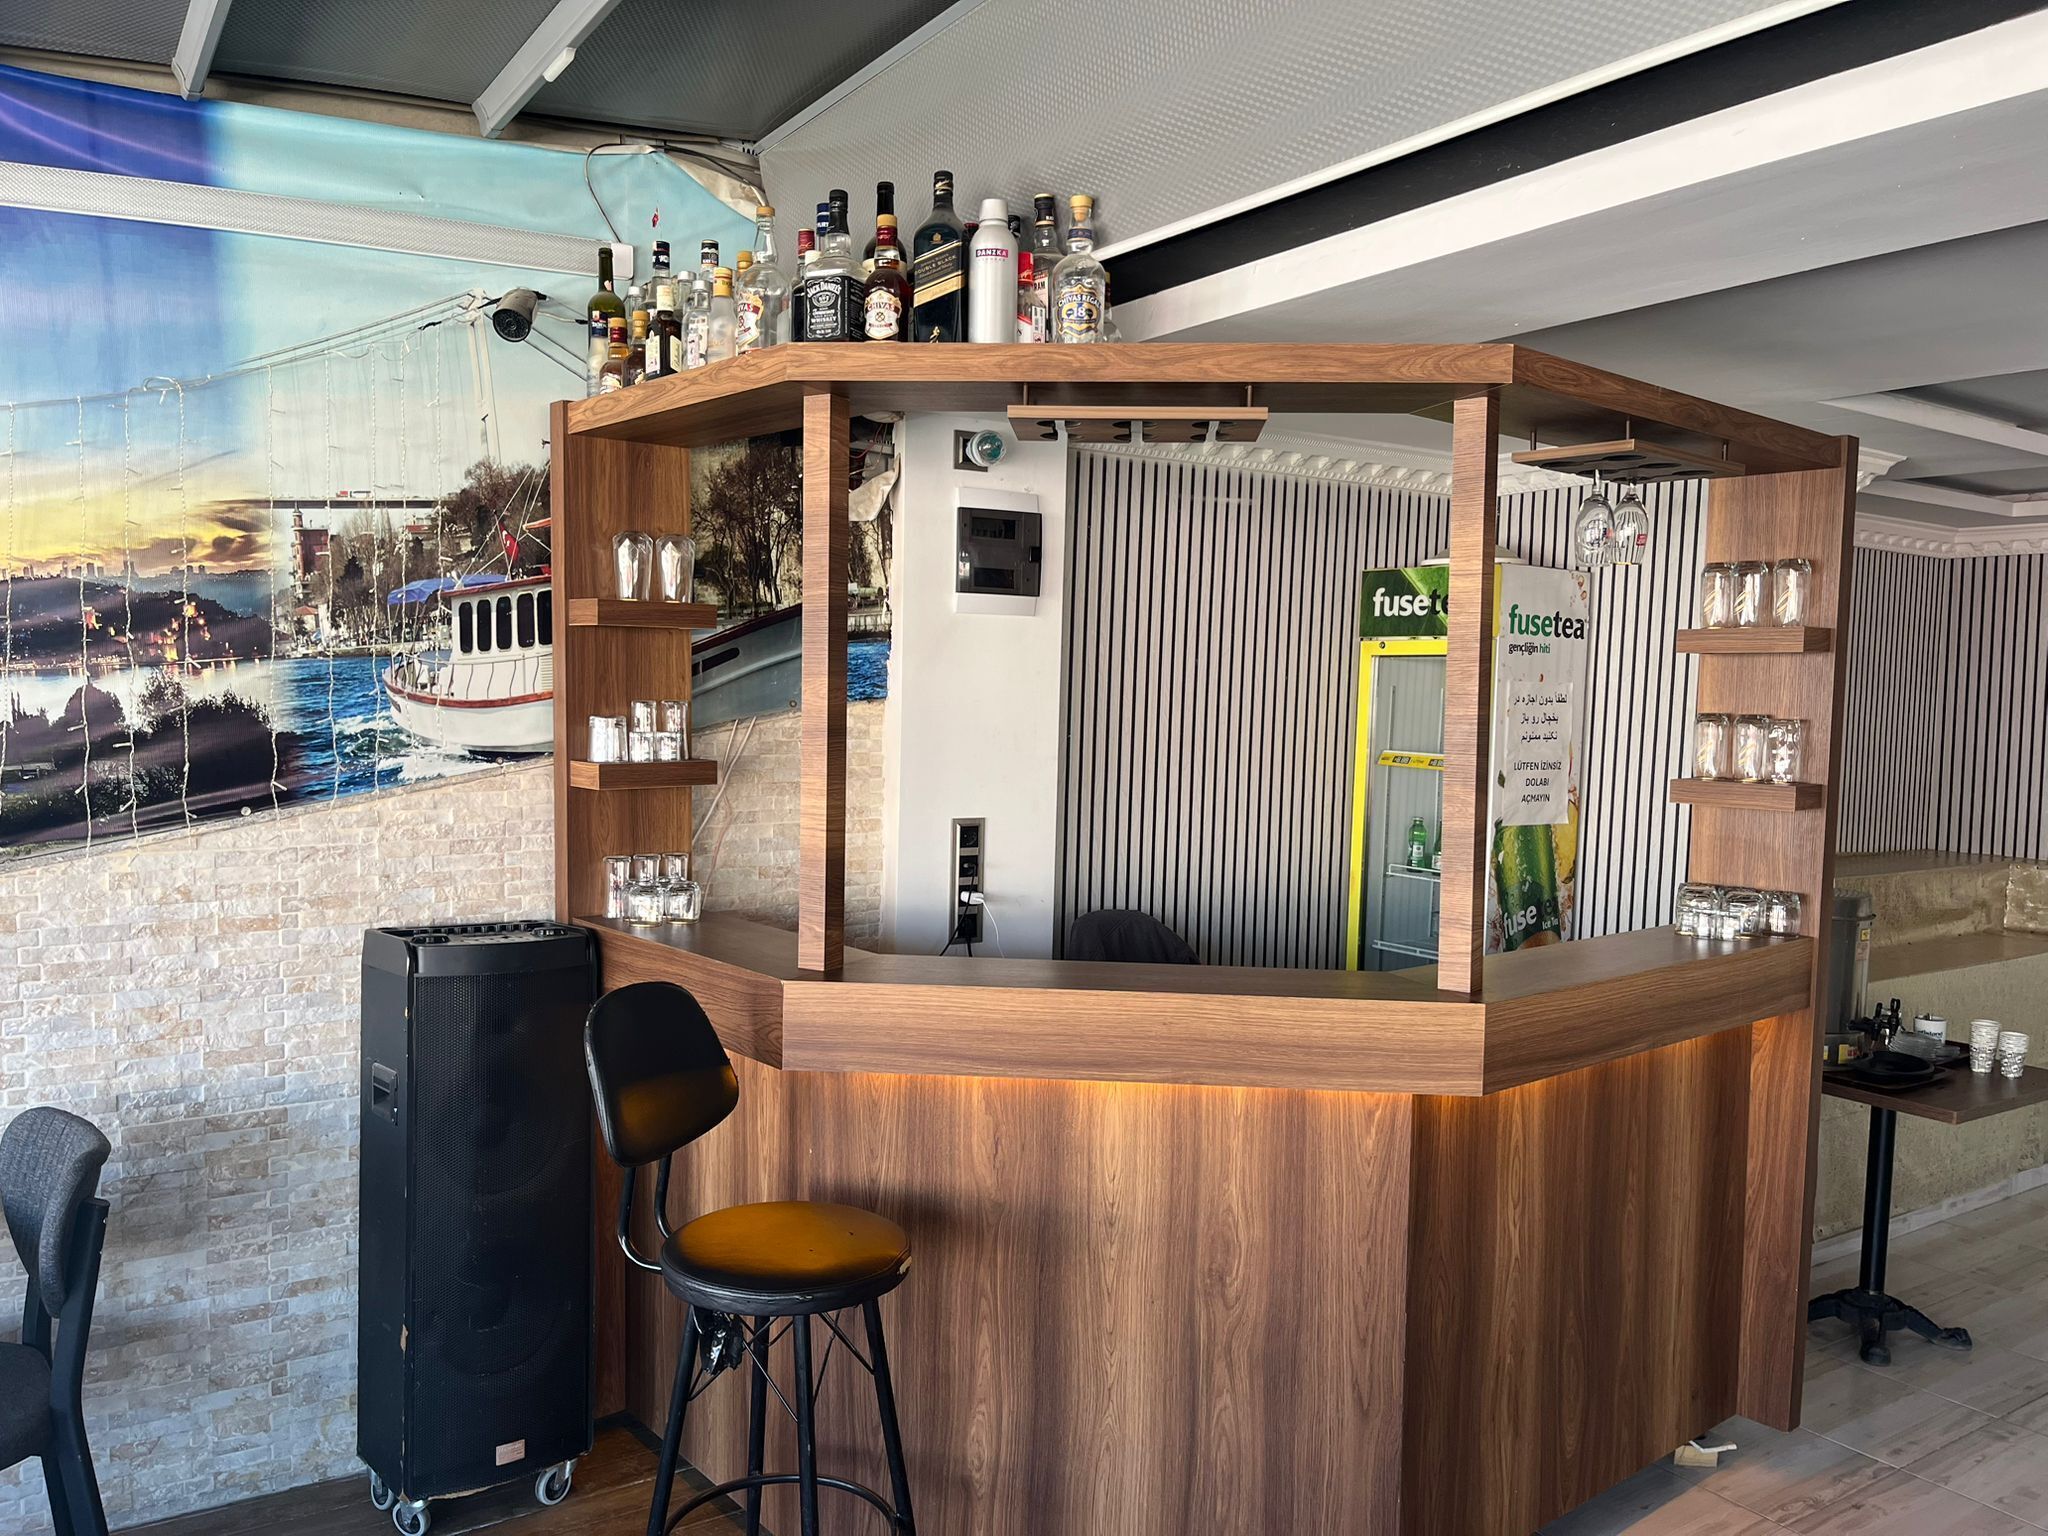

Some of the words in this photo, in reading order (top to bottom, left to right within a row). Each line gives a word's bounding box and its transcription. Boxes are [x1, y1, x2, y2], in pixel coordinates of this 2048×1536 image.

[976, 249, 1007, 257] DANZKA
[937, 255, 957, 265] BLACK
[807, 284, 820, 298] JACK
[1058, 293, 1081, 307] CHIVAS
[1082, 294, 1102, 308] REGAL
[867, 302, 895, 311] CHIVAS
[1074, 306, 1086, 317] 18
[1508, 603, 1585, 640] fusetea
[1508, 642, 1539, 656] gençliğin
[1539, 643, 1551, 654] hiti
[1513, 695, 1520, 706] در
[1522, 694, 1538, 706] اجازه
[1538, 695, 1554, 706] بدون
[1520, 713, 1530, 725] باز
[1531, 715, 1540, 725] رو
[1514, 760, 1540, 771] LÜTFEN
[1540, 759, 1562, 771] İZİNSİZ
[1525, 777, 1550, 787] DOLABI
[1521, 794, 1551, 805] AÇMAYIN
[1503, 905, 1537, 940] fuse
[1541, 920, 1552, 930] Ice
